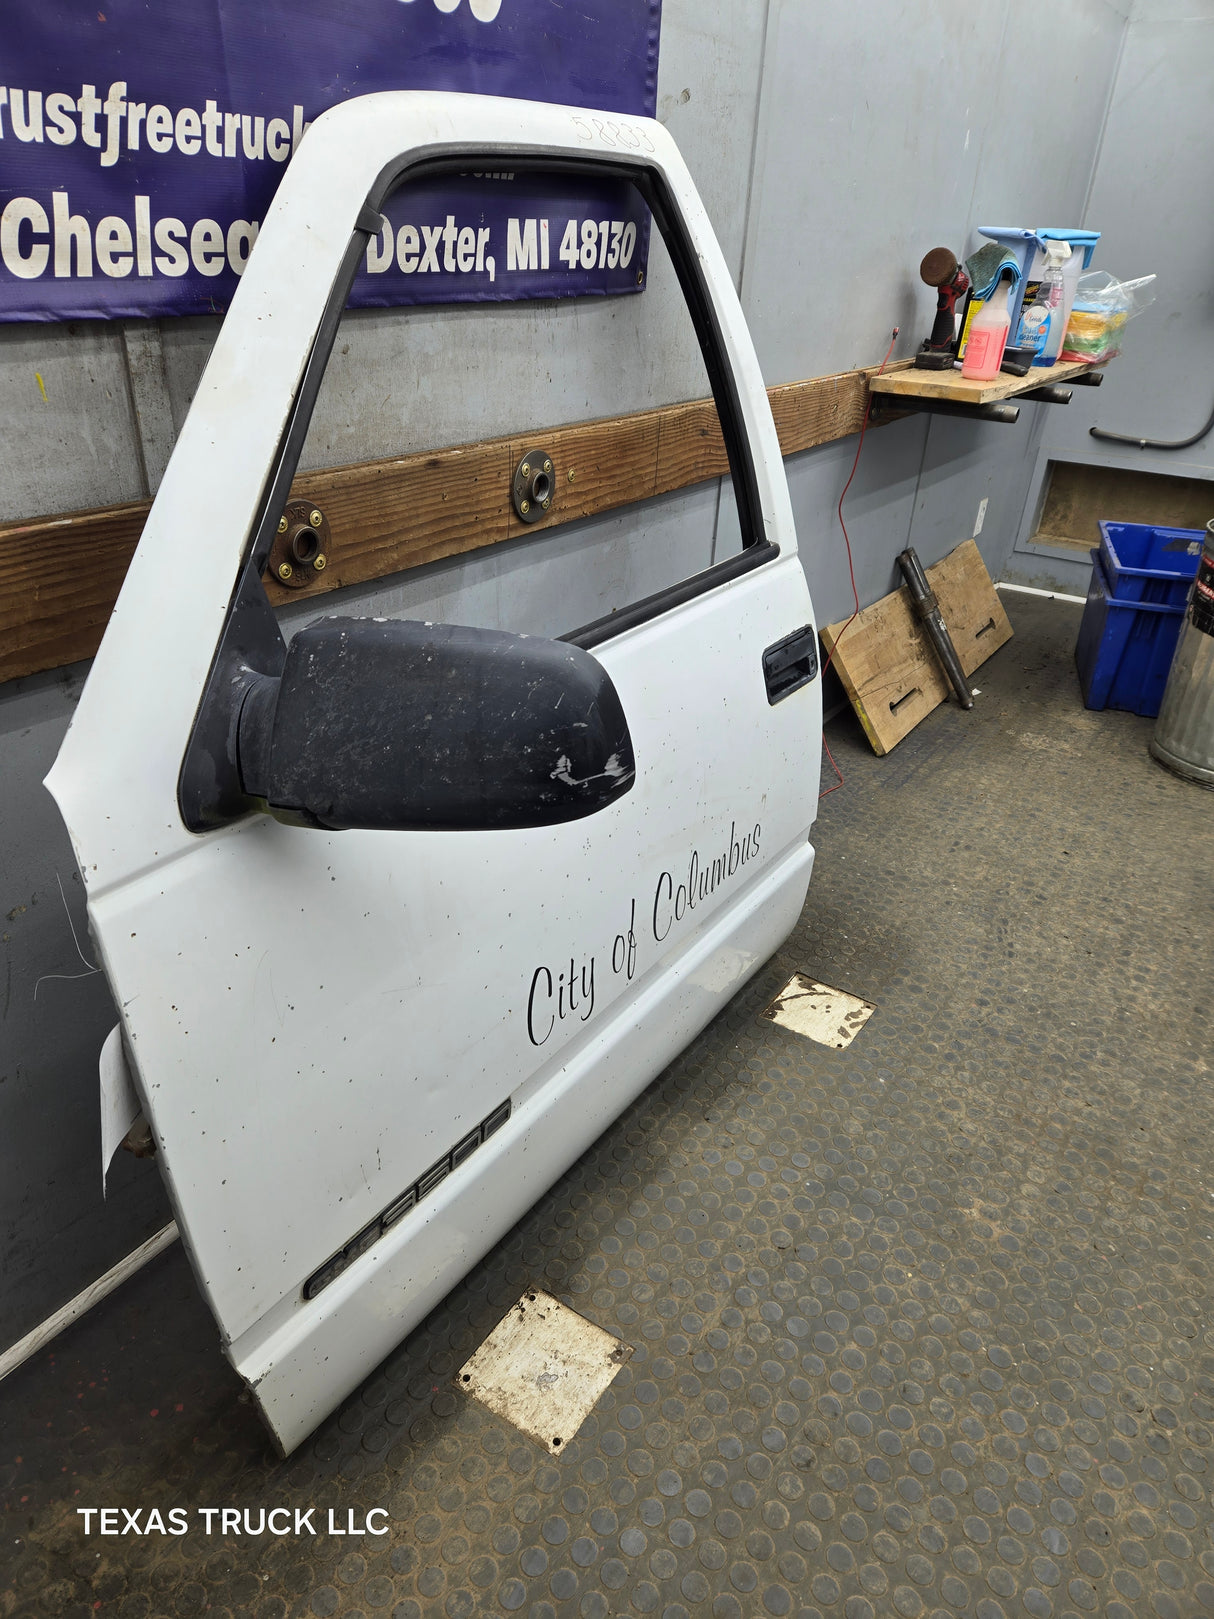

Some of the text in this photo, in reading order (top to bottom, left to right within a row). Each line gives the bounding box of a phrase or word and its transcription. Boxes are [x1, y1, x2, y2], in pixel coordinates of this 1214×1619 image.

[366, 213, 496, 282] Dexter,
[507, 217, 550, 271] MI
[559, 219, 637, 270] 48130
[527, 821, 761, 1047] City of Columbus
